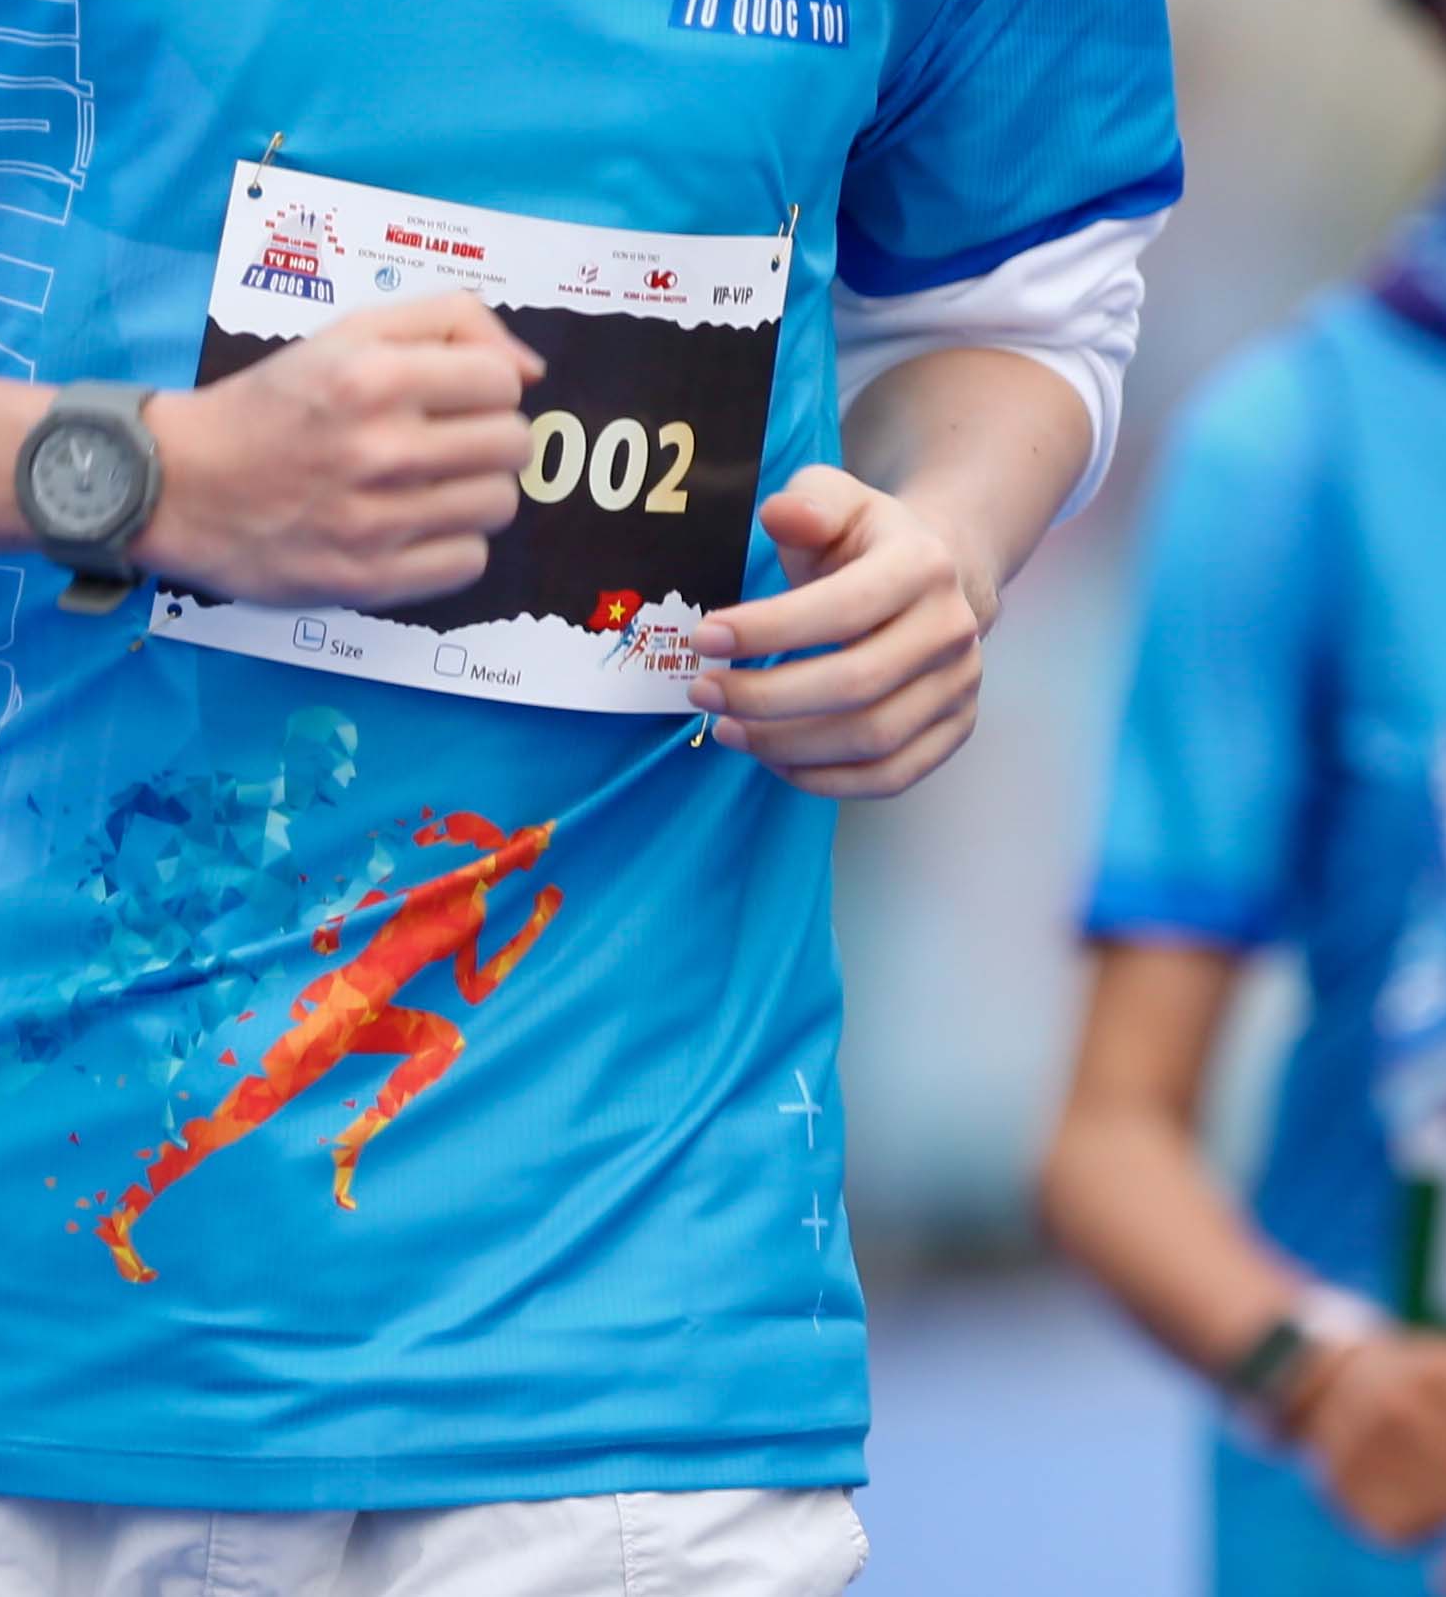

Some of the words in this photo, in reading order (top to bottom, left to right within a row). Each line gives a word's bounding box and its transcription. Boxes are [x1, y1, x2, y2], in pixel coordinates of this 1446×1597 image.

[425, 235, 449, 254] LAO
[712, 285, 754, 305] VIP-VIP
[330, 639, 364, 660] Size
[469, 663, 522, 687] Medal
